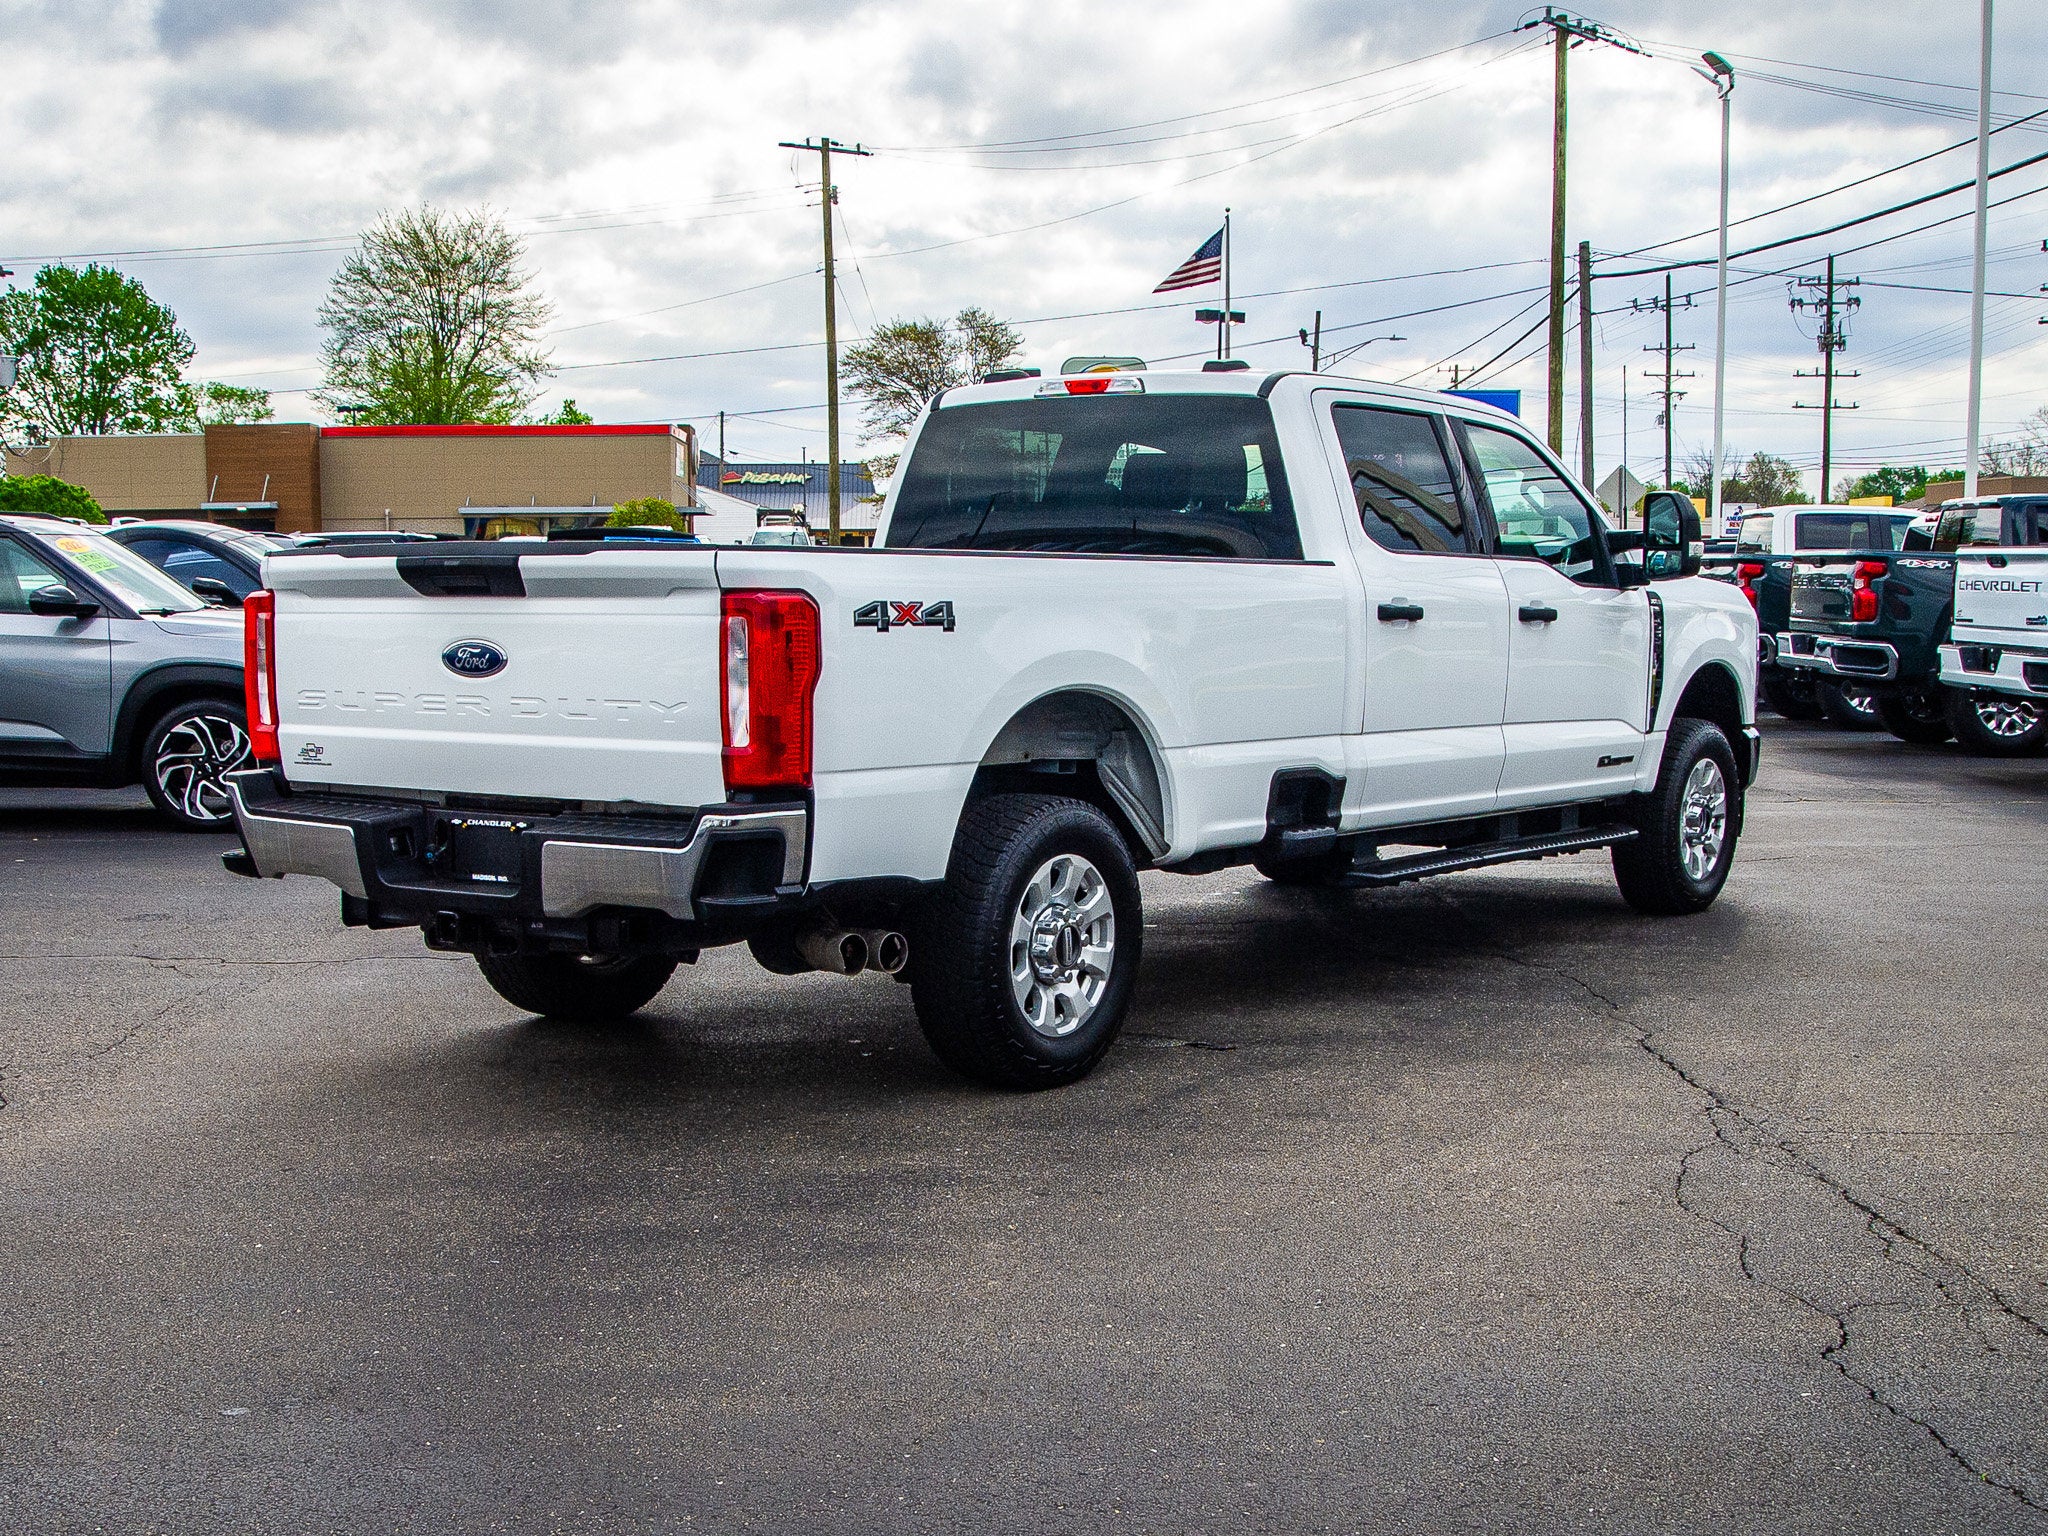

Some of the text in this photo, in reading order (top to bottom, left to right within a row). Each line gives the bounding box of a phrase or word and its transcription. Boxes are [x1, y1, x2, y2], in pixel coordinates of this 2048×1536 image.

[740, 471, 812, 485] Pizza Hut
[1959, 580, 2043, 592] CHEVROLET
[454, 647, 490, 669] Ford
[298, 689, 689, 724] SUPER DUTY
[467, 819, 512, 828] CHANDLER
